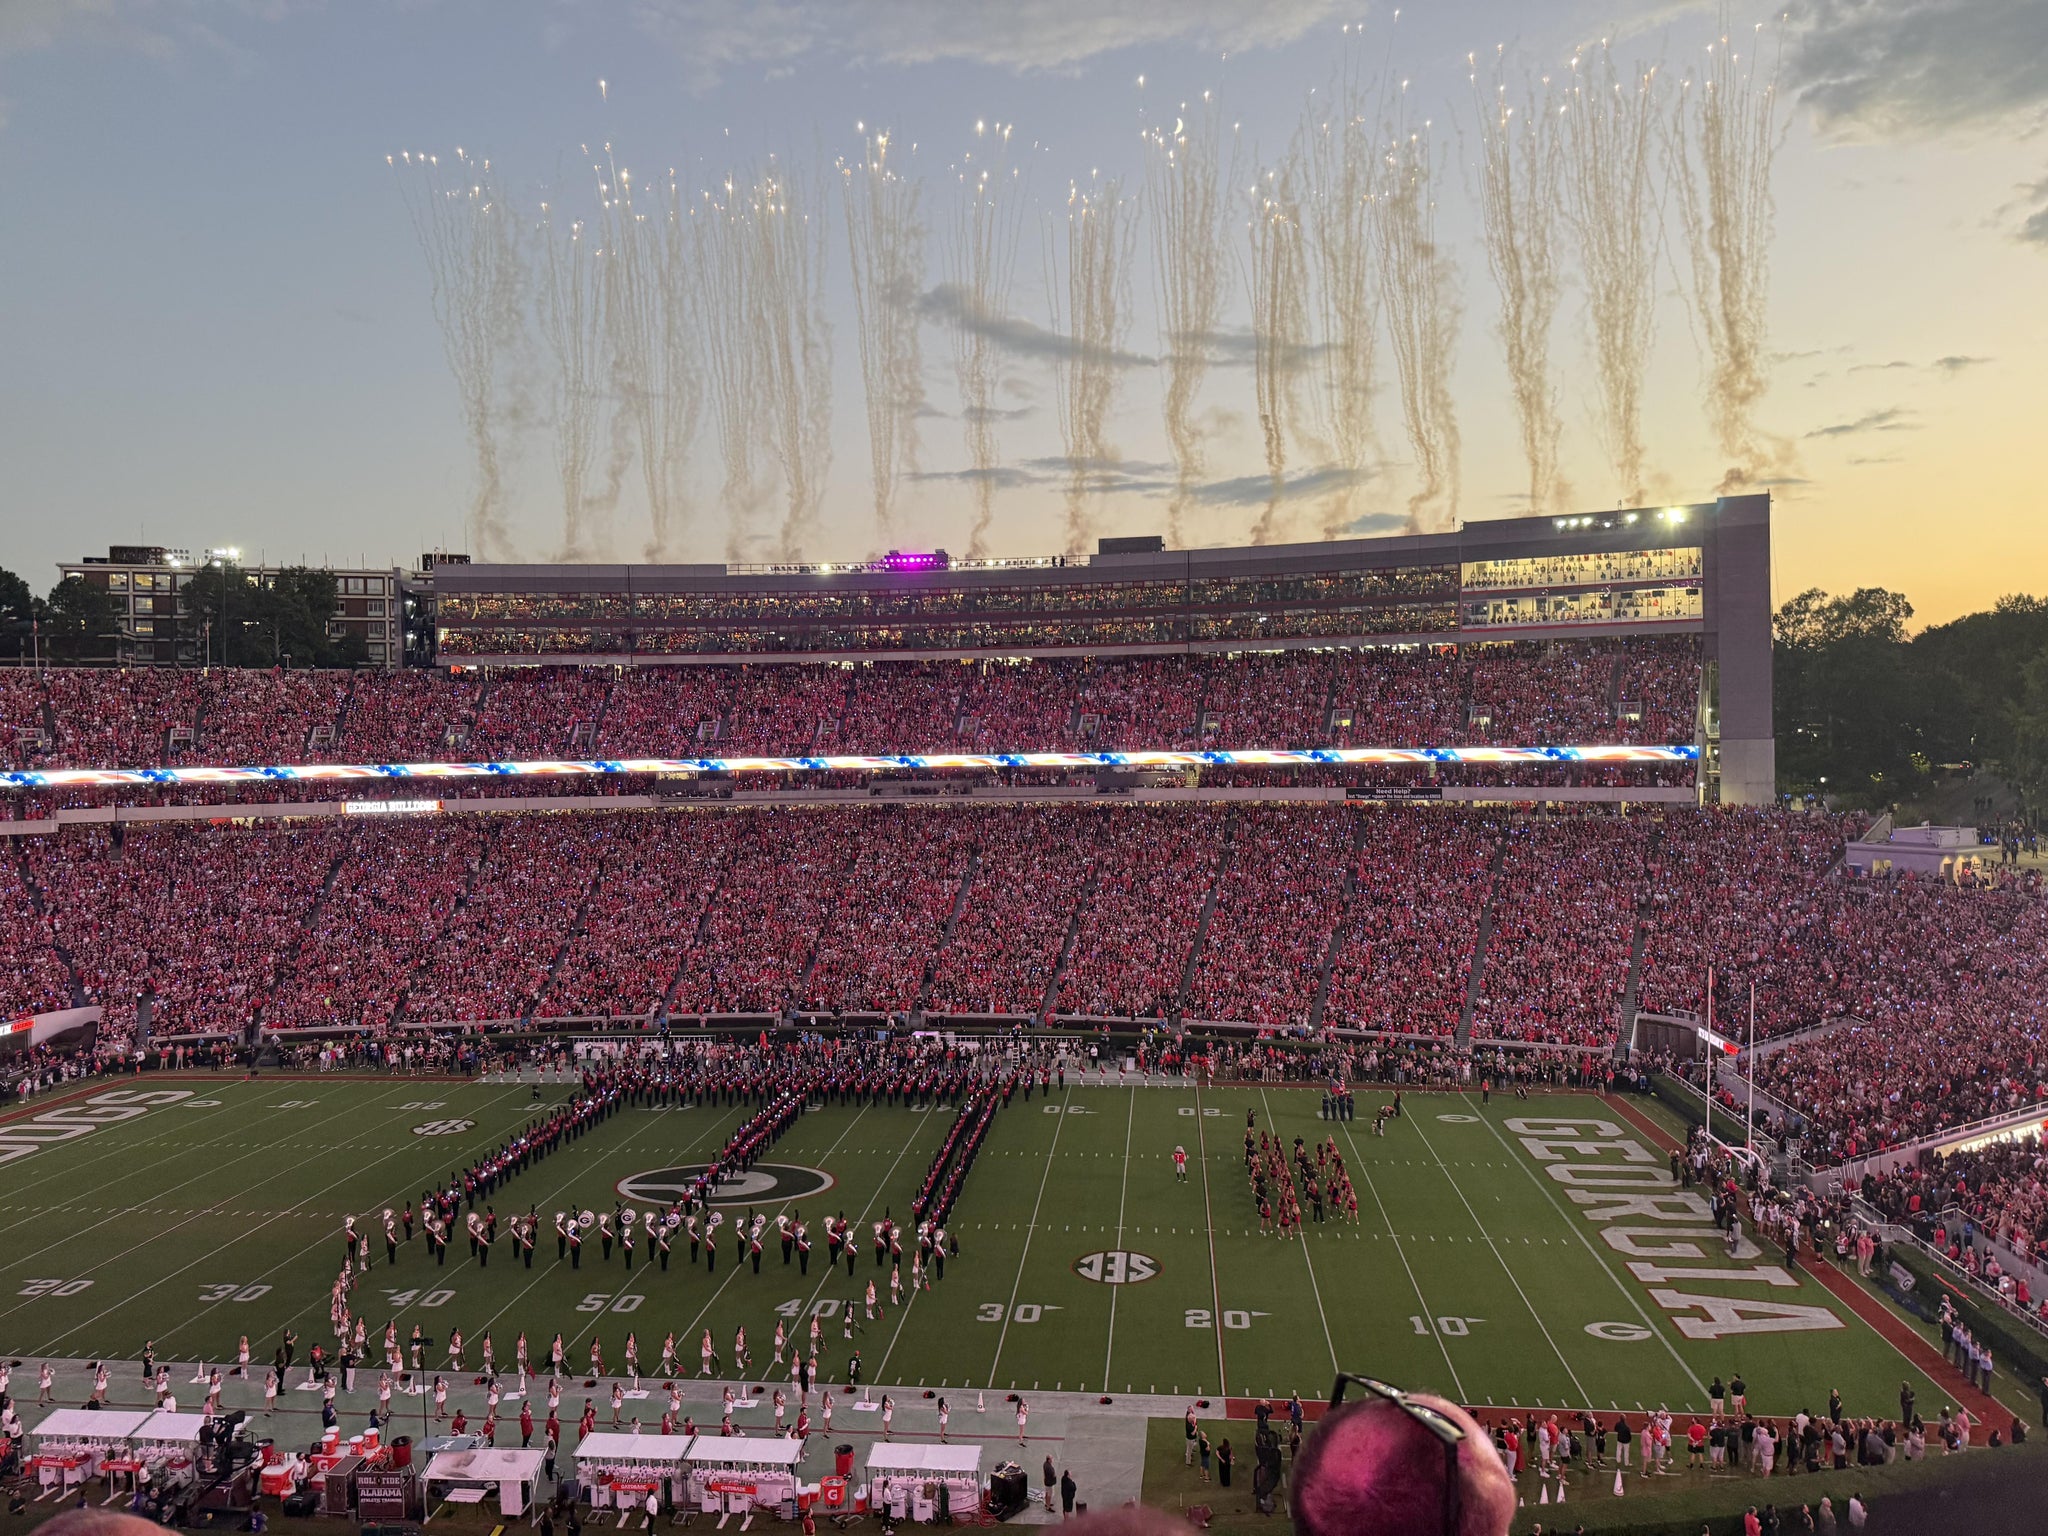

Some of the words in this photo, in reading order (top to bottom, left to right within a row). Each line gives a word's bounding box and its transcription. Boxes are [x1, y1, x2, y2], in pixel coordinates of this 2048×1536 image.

[346, 801, 388, 813] GEORGIA
[388, 800, 437, 812] BULLDOGS
[1503, 1117, 1847, 1340] GEORGIA
[1076, 1251, 1157, 1283] SEC
[16, 1279, 95, 1296] 20
[198, 1284, 273, 1301] 30
[387, 1289, 456, 1307] 40
[575, 1294, 645, 1313] 50
[774, 1298, 840, 1317] 40
[976, 1303, 1042, 1323] 30
[1185, 1309, 1251, 1329] 20
[1409, 1316, 1470, 1336] 10
[1584, 1321, 1652, 1341] G
[827, 1490, 838, 1500] G
